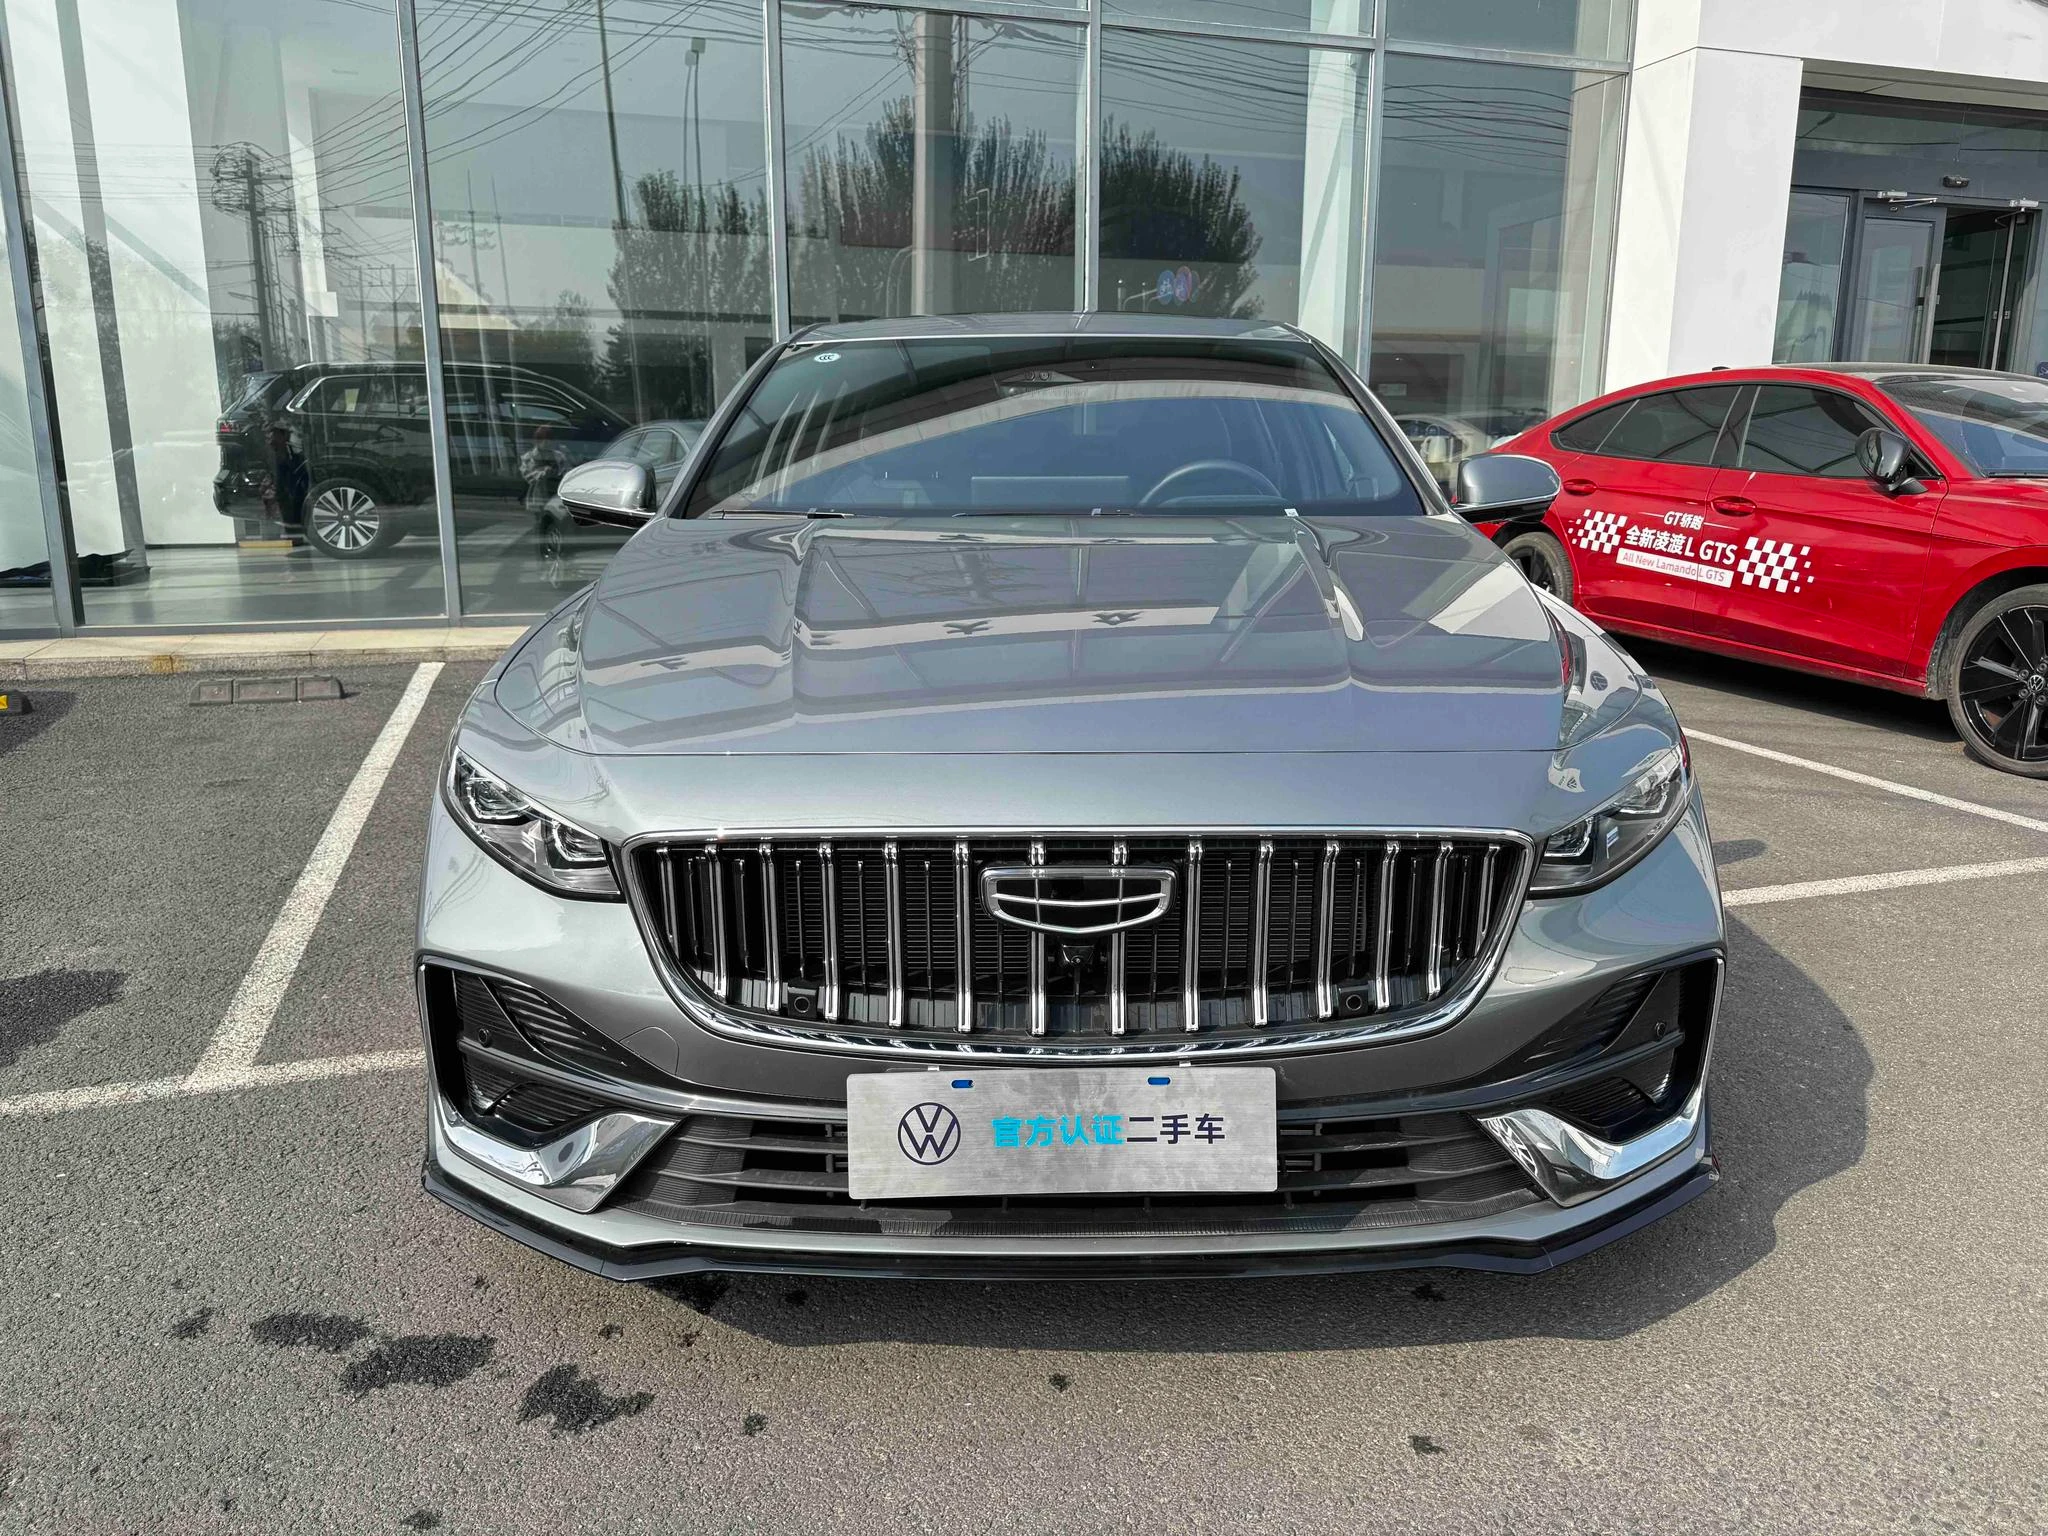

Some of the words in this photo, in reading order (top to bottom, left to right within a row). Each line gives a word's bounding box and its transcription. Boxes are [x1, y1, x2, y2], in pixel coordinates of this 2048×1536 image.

[1663, 510, 1704, 530] GT轿跑
[1622, 552, 1634, 563] All
[1635, 555, 1655, 567] New
[1656, 558, 1697, 576] Lamando
[1698, 568, 1704, 578] L
[1705, 569, 1725, 583] GTS
[1699, 540, 1738, 565] GTS
[898, 1102, 961, 1166] VW
[991, 1113, 1226, 1148] 官方认证二手车
